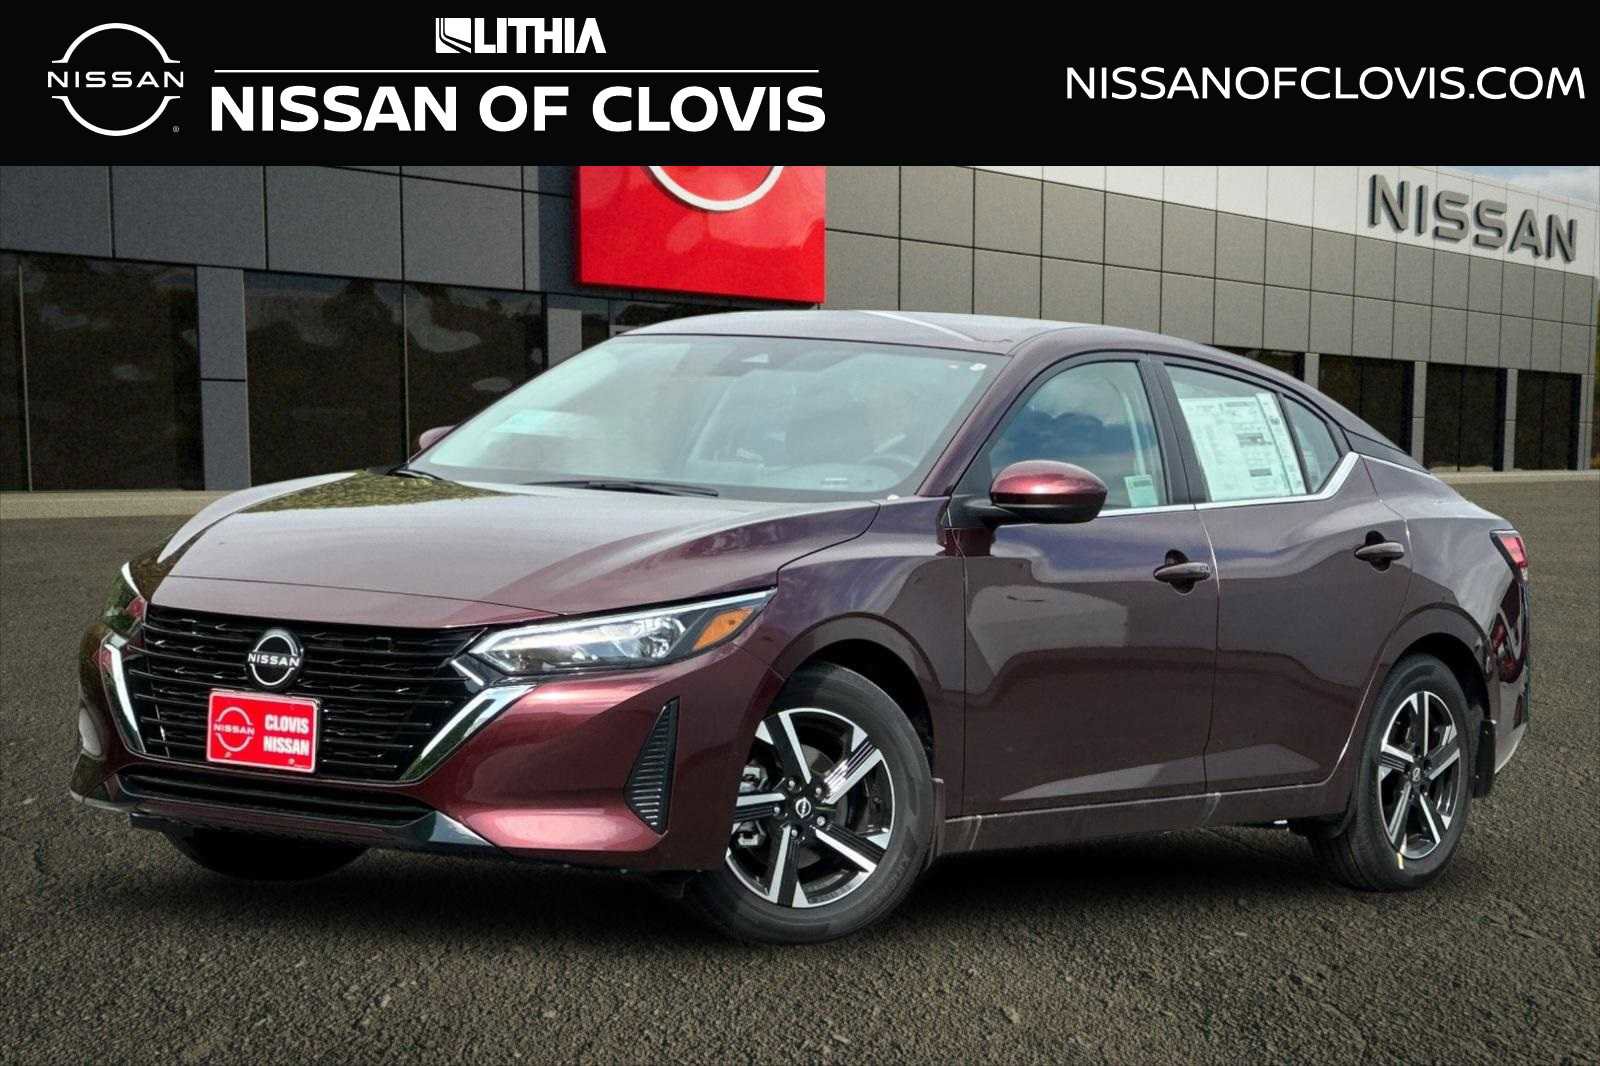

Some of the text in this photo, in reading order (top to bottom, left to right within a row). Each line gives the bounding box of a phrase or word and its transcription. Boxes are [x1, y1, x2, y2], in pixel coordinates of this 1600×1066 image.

[1368, 173, 1578, 264] NISSAN
[247, 653, 300, 667] NISSAN
[213, 723, 255, 736] NISSAN
[265, 714, 309, 735] CLOVIS
[263, 736, 310, 756] NISSAN
